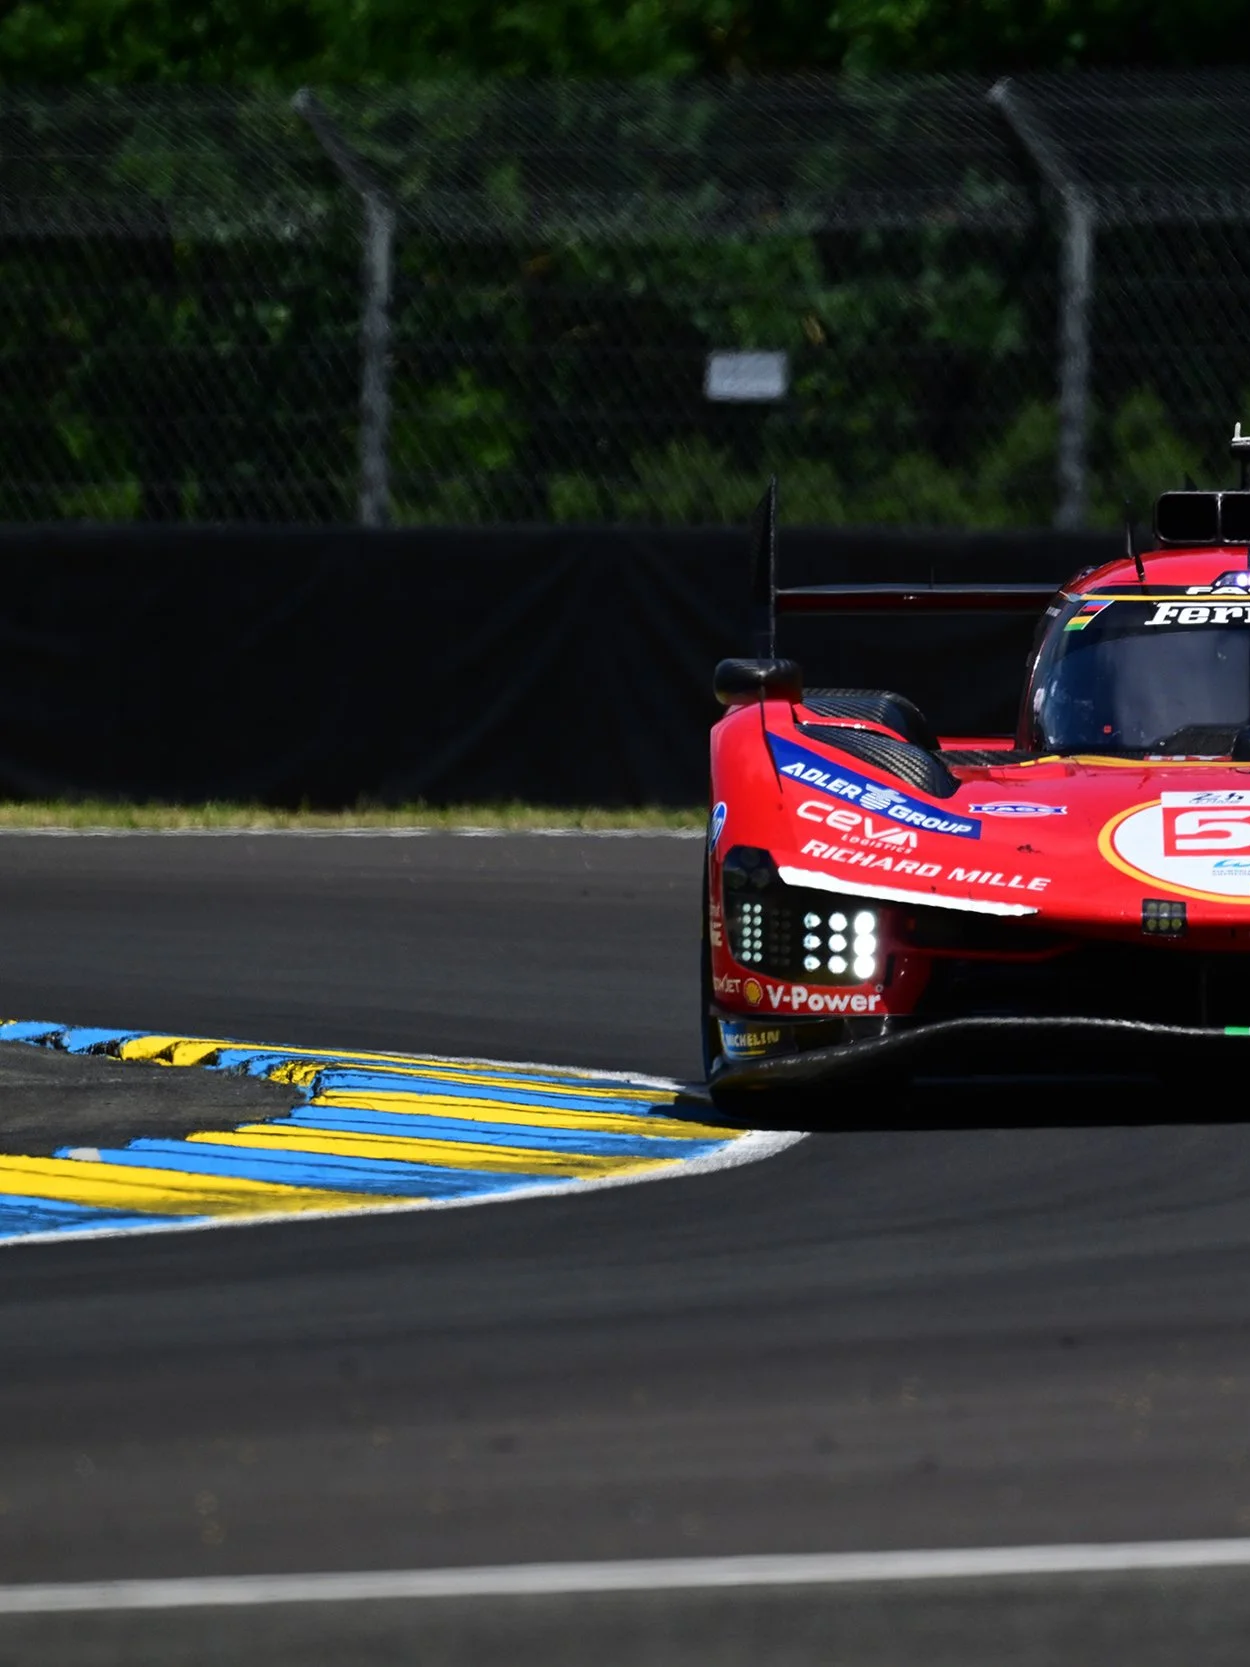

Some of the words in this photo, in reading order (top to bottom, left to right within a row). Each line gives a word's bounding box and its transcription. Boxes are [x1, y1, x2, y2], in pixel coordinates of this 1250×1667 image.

[781, 763, 860, 800] ADLER
[887, 804, 973, 835] GROUP
[840, 833, 913, 854] LOGISTICS
[800, 839, 943, 878] RICHARD
[947, 867, 1052, 891] MILLE
[766, 985, 881, 1012] V-Power
